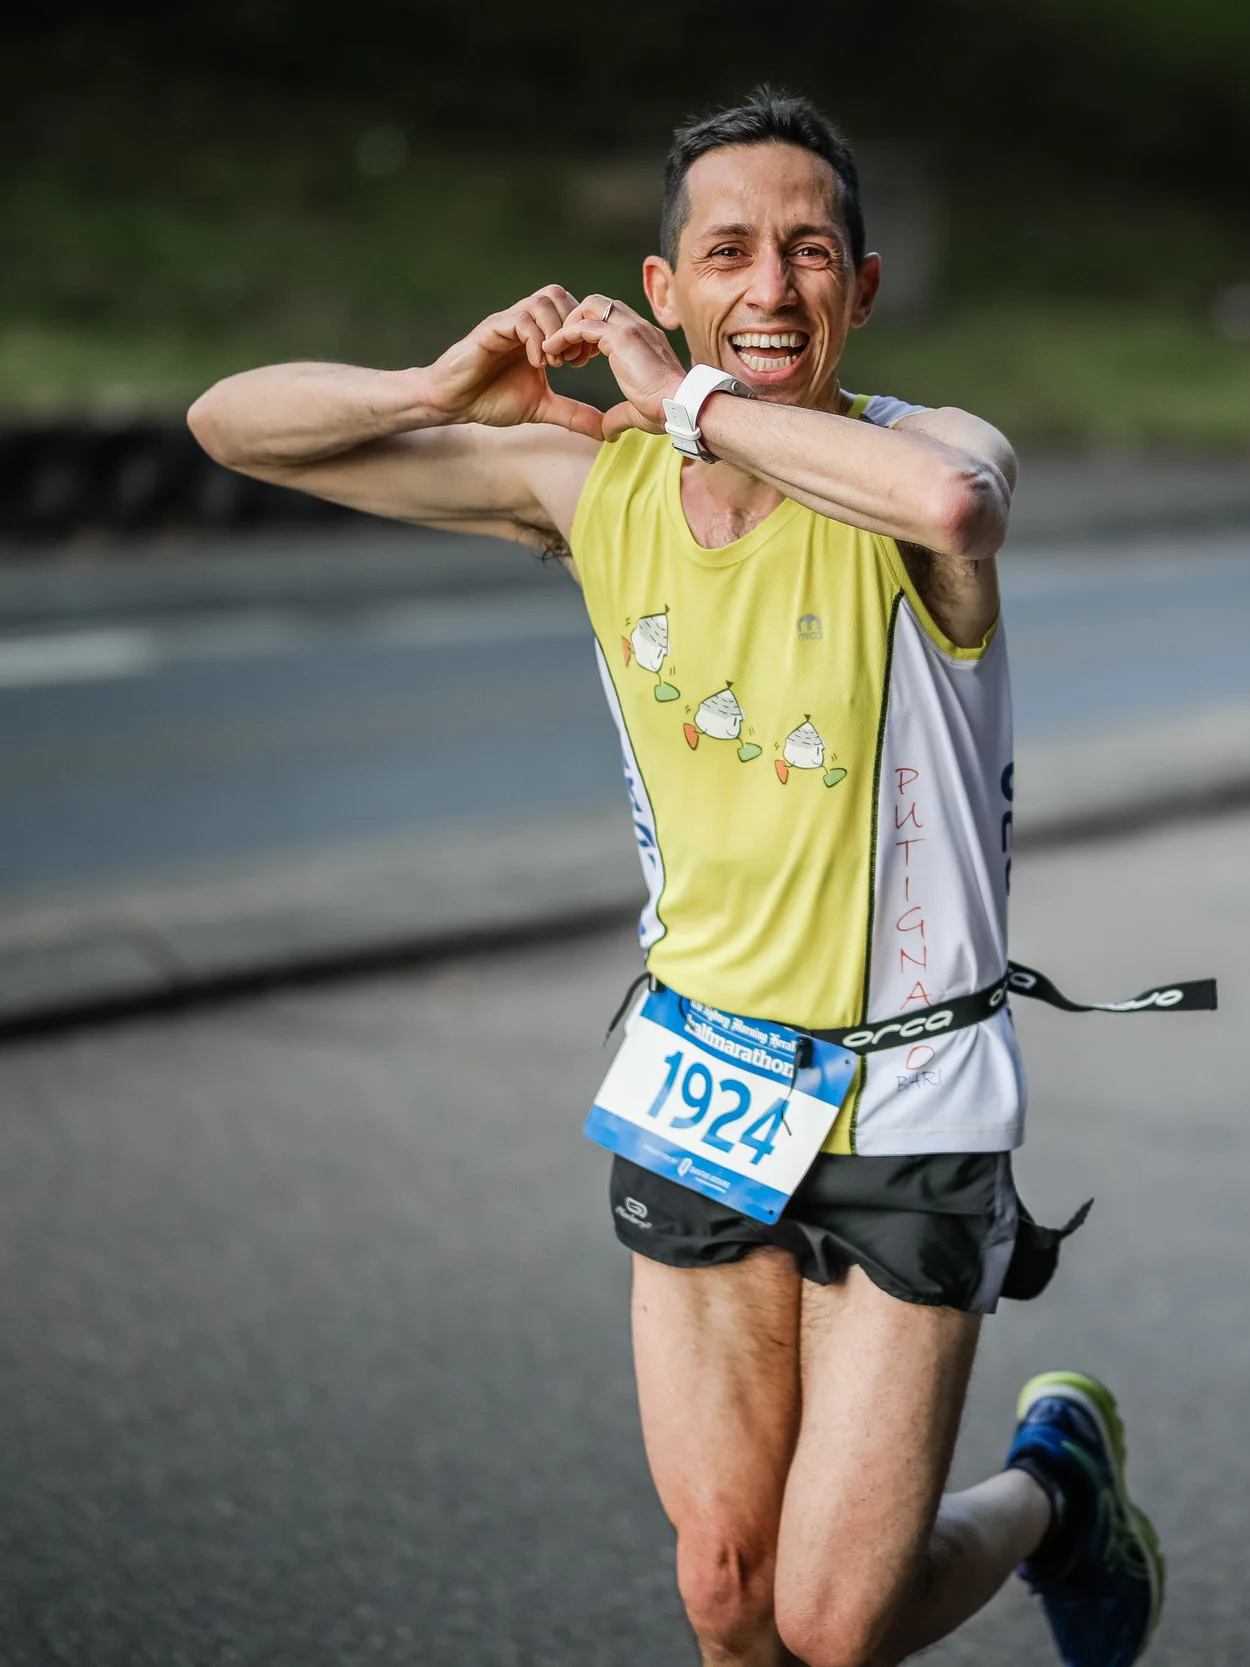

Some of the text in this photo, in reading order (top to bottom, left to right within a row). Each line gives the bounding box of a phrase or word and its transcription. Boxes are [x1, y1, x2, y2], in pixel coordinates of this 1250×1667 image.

[842, 1010, 954, 1048] orca
[896, 1069, 942, 1093] BARI
[647, 1049, 790, 1166] 1924
